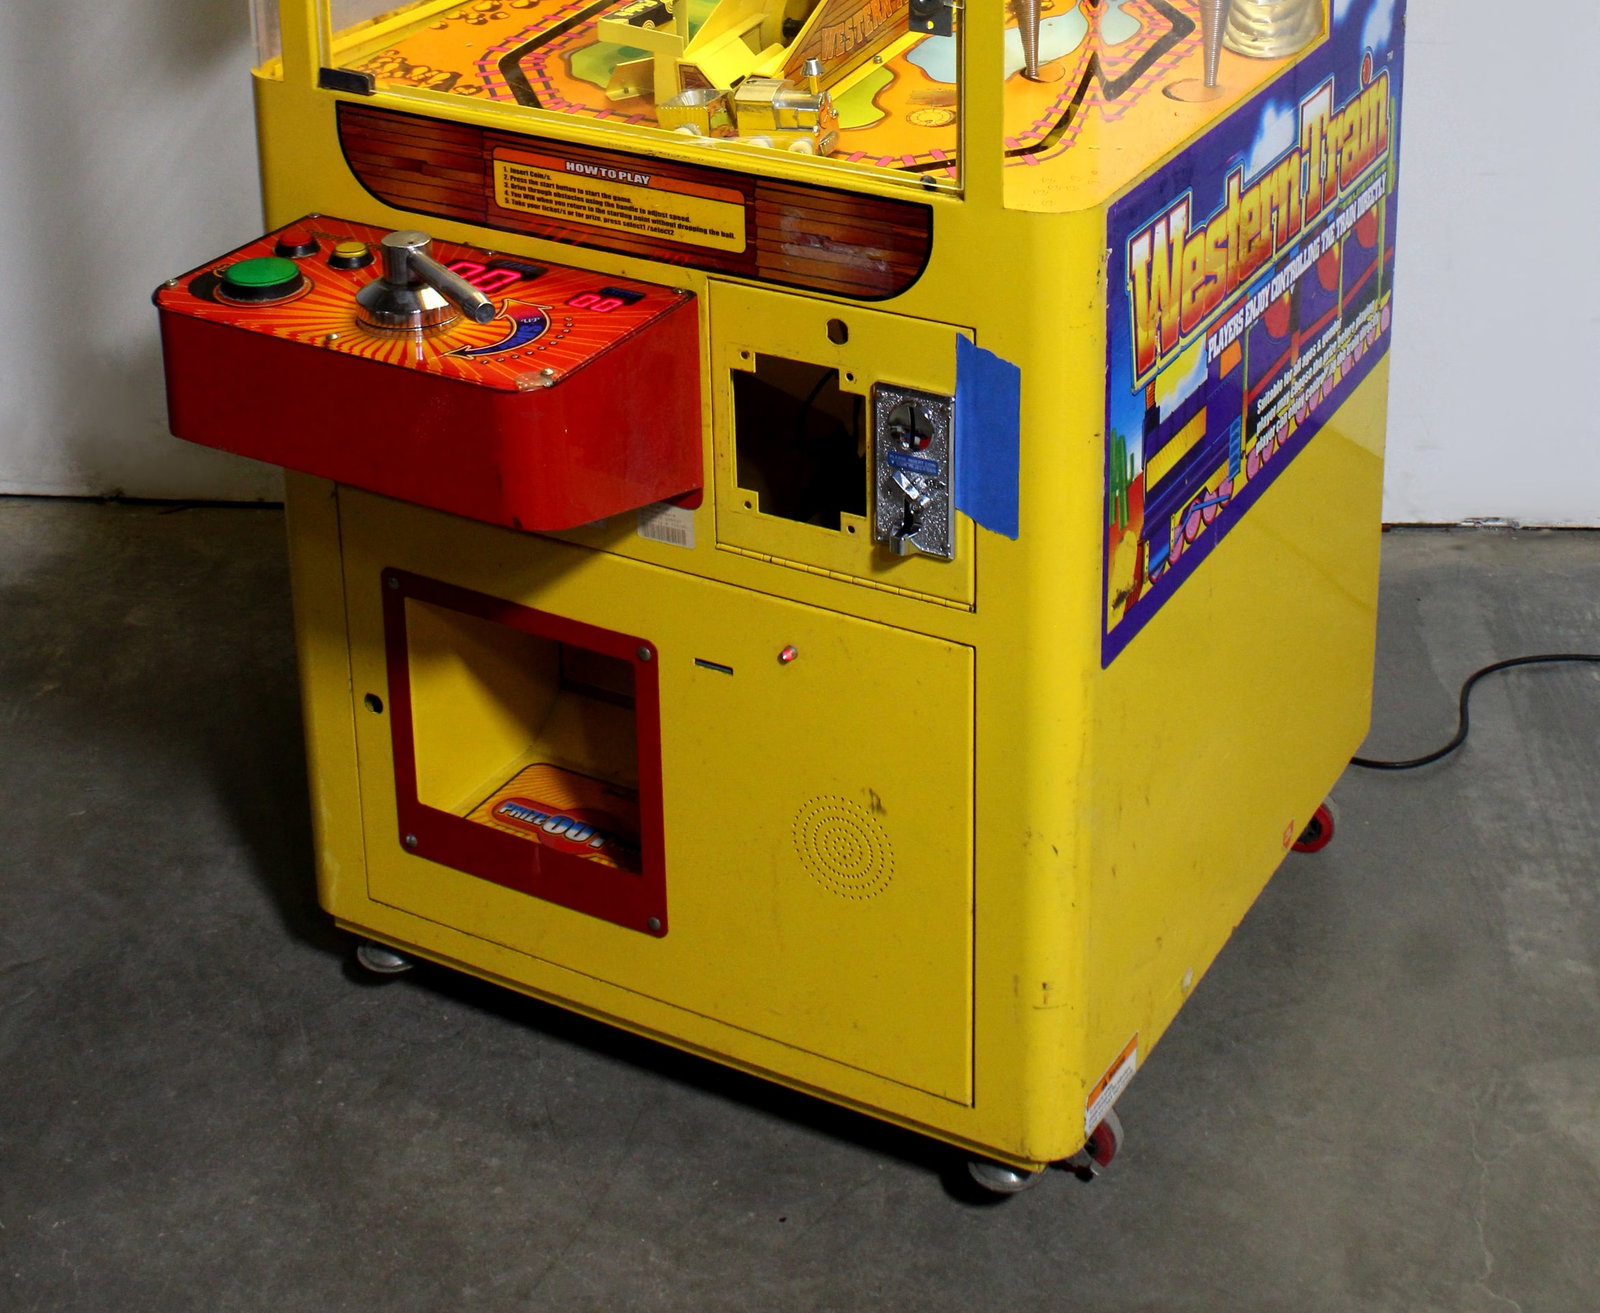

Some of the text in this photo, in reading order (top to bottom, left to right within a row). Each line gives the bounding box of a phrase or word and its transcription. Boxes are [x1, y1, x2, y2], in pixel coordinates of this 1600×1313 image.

[510, 167, 529, 176] Insert
[529, 171, 551, 180] Coin/s.
[510, 175, 527, 183] Press
[556, 184, 576, 192] button
[585, 189, 600, 197] start
[612, 194, 632, 204] game.
[566, 161, 650, 185] HOW TO PLAY
[510, 183, 526, 191] Drive
[528, 186, 552, 196] through
[553, 191, 584, 202] obstacles
[585, 197, 603, 206] using
[616, 203, 638, 212] handle
[647, 209, 668, 218] adjust
[669, 213, 691, 222] speed.
[527, 202, 540, 210] your
[542, 205, 566, 214] ticket/s
[603, 217, 621, 225] press
[567, 202, 586, 210] return
[607, 209, 632, 220] starting
[633, 214, 650, 223] point
[651, 218, 676, 228] without
[677, 222, 707, 234] dropping
[721, 231, 735, 239] ball.
[1128, 54, 1390, 382] Western Train
[1207, 171, 1387, 363] PLAYERS ENJOY CONTROLLING THE TRAIN DIRECTLY
[1257, 378, 1283, 414] Suitable
[1284, 369, 1293, 387] for
[1293, 357, 1302, 377] all
[1257, 405, 1276, 436] player
[1277, 390, 1290, 414] may
[1291, 367, 1312, 398] choose
[1313, 356, 1322, 375] the
[1255, 424, 1276, 456] player
[1276, 411, 1287, 432] can
[1288, 393, 1304, 420] enjoy
[498, 802, 549, 826] PRIZE
